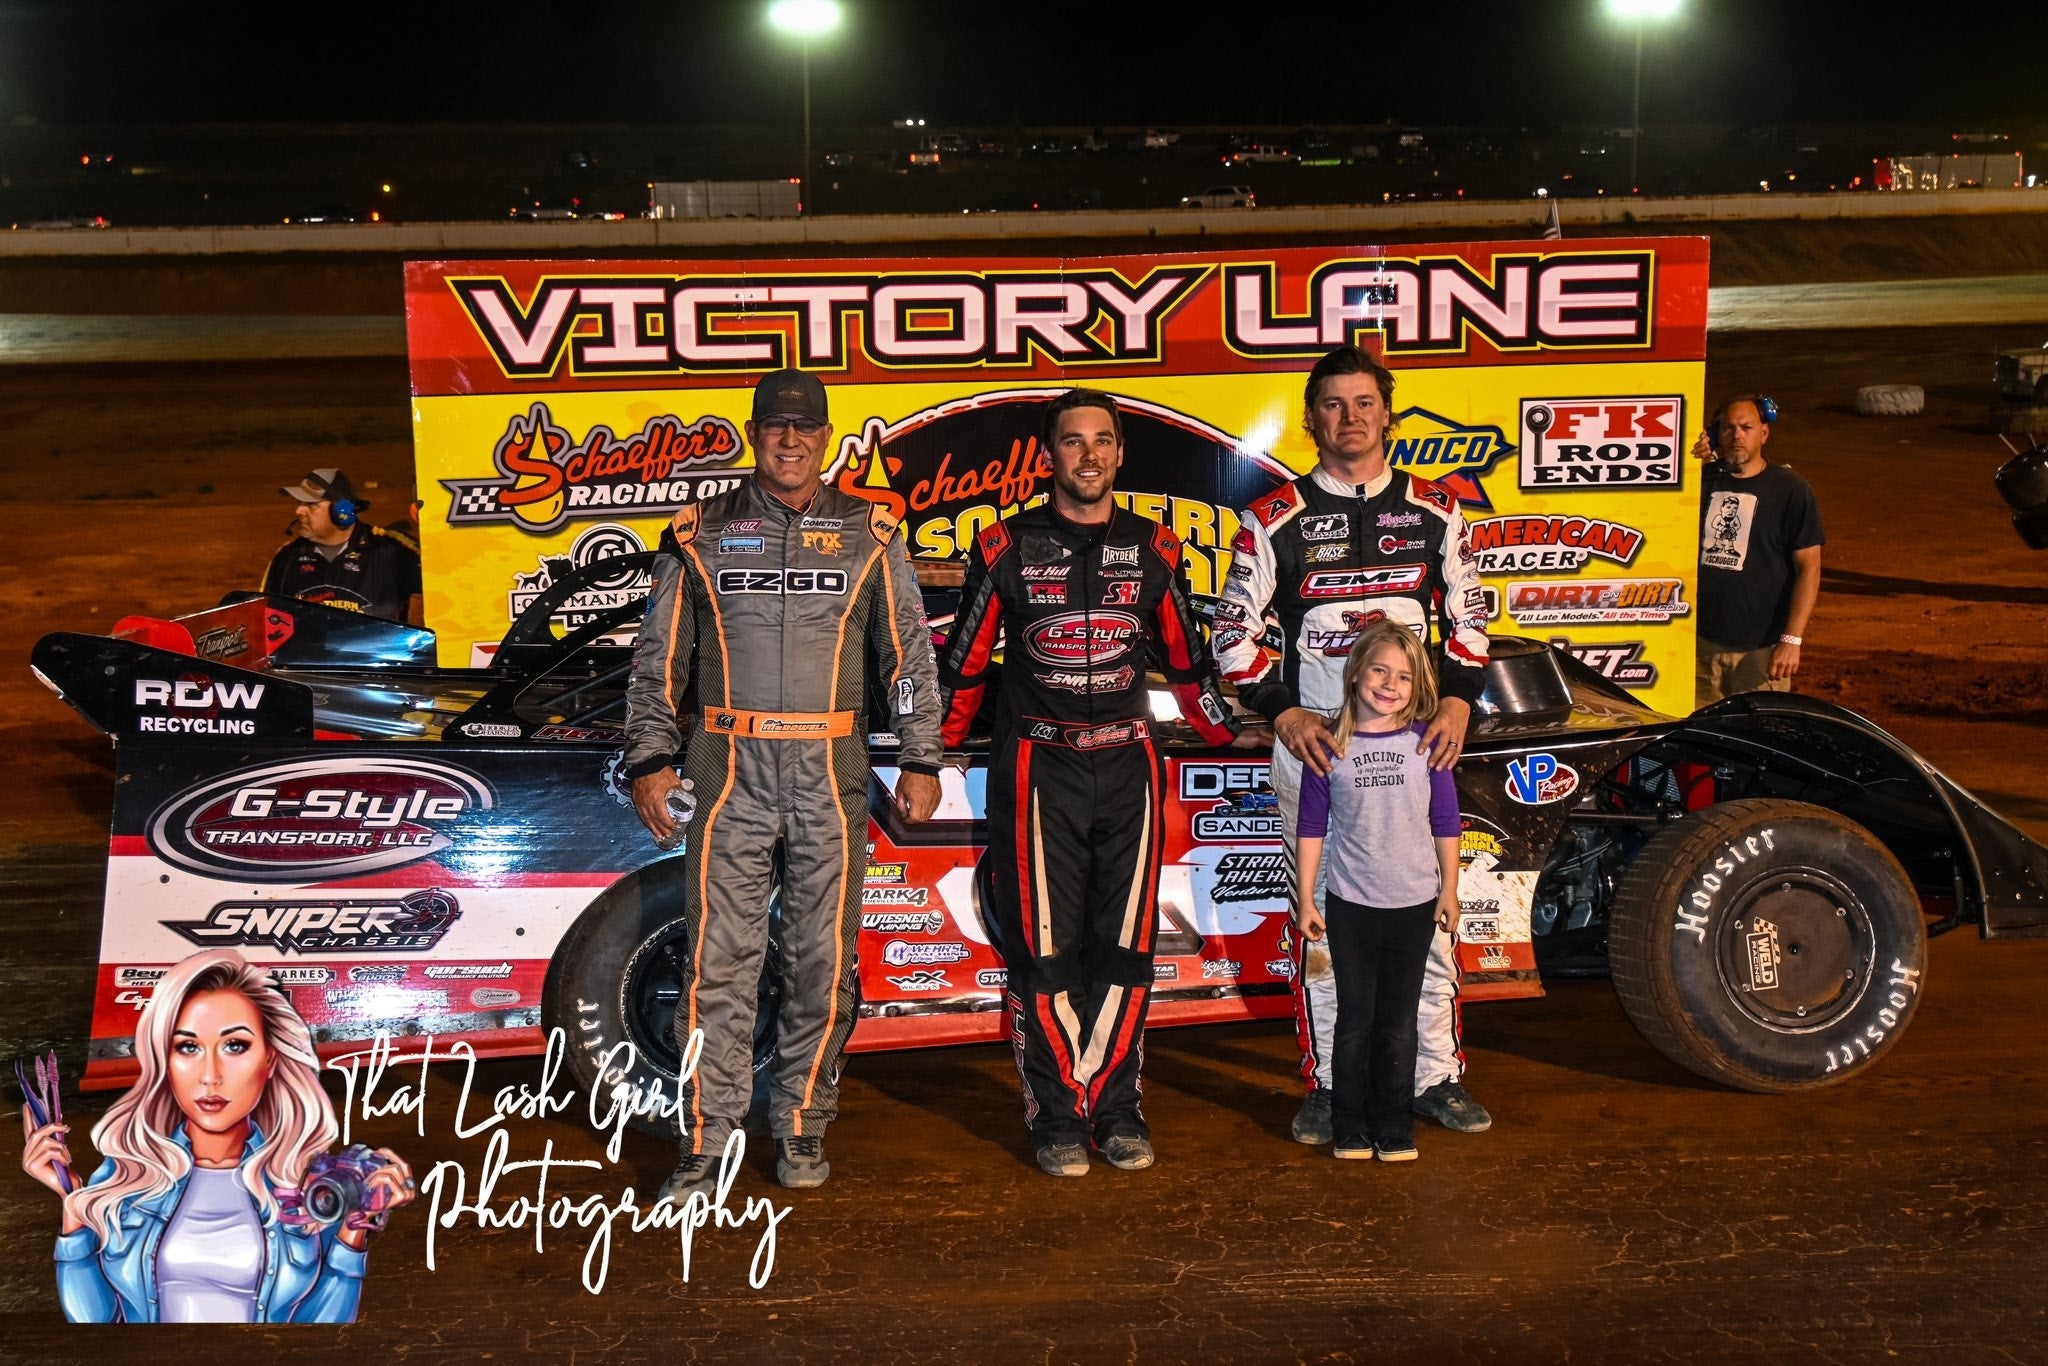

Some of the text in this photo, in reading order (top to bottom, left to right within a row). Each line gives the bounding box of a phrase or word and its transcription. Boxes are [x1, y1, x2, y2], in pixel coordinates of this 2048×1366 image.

[468, 263, 1642, 366] VICTORY LANE
[1545, 405, 1674, 440] FK
[1384, 435, 1493, 466] NOCO
[1557, 443, 1672, 463] ROD
[499, 421, 734, 507] Schaeffer's
[1533, 463, 1672, 484] ENDS
[568, 481, 693, 507] RACING
[729, 521, 759, 530] KLOTZ
[802, 519, 842, 528] COMETIC
[1314, 519, 1334, 532] H
[1376, 511, 1422, 526] Hoosier
[802, 532, 842, 550] FOX
[1470, 518, 1638, 559] MERICAN
[1102, 547, 1139, 565] DRYDENE
[1315, 547, 1347, 559] BASE
[1480, 550, 1577, 570] RACER
[1043, 566, 1072, 577] Hill
[1515, 585, 1609, 608] DIRT
[1601, 591, 1620, 599] ON
[1617, 581, 1679, 608] DIRT
[1519, 610, 1667, 622] All Late Models. All the Time.
[1047, 626, 1132, 643] G-Style
[135, 679, 265, 710] RDW
[140, 716, 256, 735] RECYCLING
[1352, 751, 1405, 768] RACING
[1354, 774, 1405, 788] SEASON
[1506, 753, 1558, 804] VP
[229, 786, 465, 828] G-Style
[204, 829, 433, 848] TRANSPORT, LLC
[1674, 828, 1775, 944] Hoosier
[191, 903, 402, 937] SNIPER
[862, 913, 930, 928] WIESNER
[877, 922, 923, 931] MINING
[300, 934, 434, 948] CHASSIS
[911, 945, 961, 953] WEHRS
[1750, 940, 1762, 985] RACING
[1758, 936, 1773, 985] WELD
[271, 969, 325, 980] BARNES
[1825, 957, 1921, 1073] Hoosier
